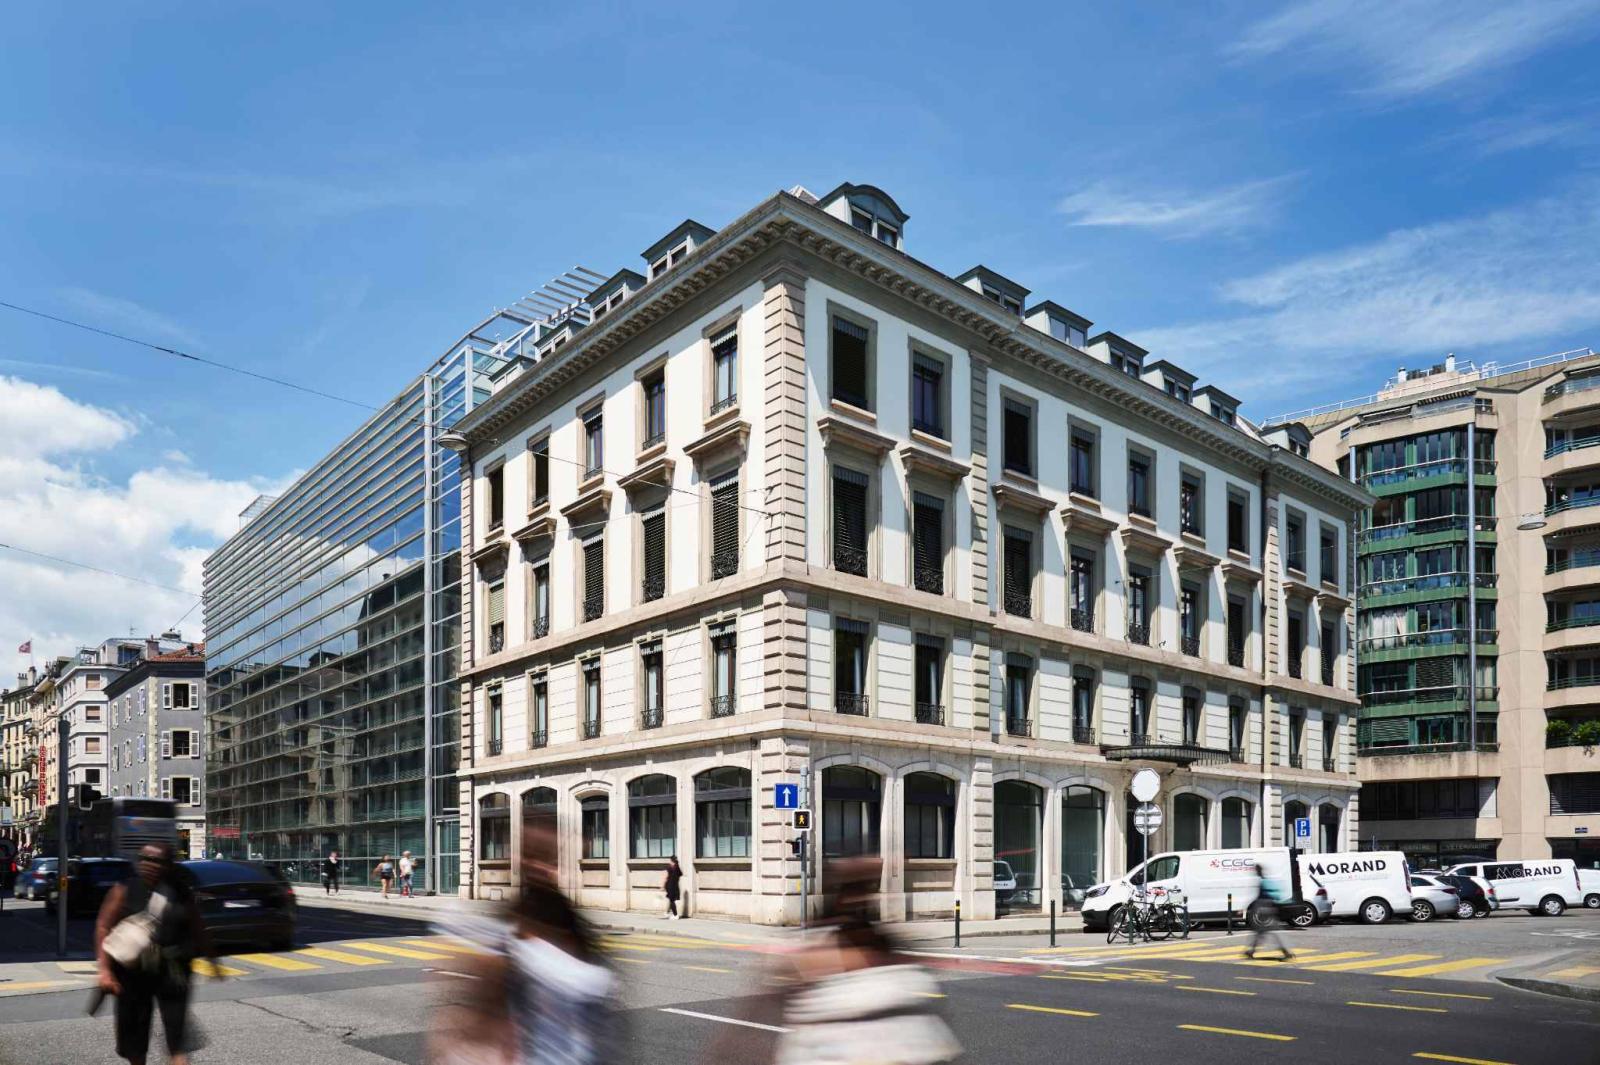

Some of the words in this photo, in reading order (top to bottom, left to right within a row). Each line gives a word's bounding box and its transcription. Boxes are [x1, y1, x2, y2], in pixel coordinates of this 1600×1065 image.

[1221, 858, 1254, 867] CGC
[1308, 860, 1386, 875] MORAND
[1496, 866, 1562, 880] MORAND
